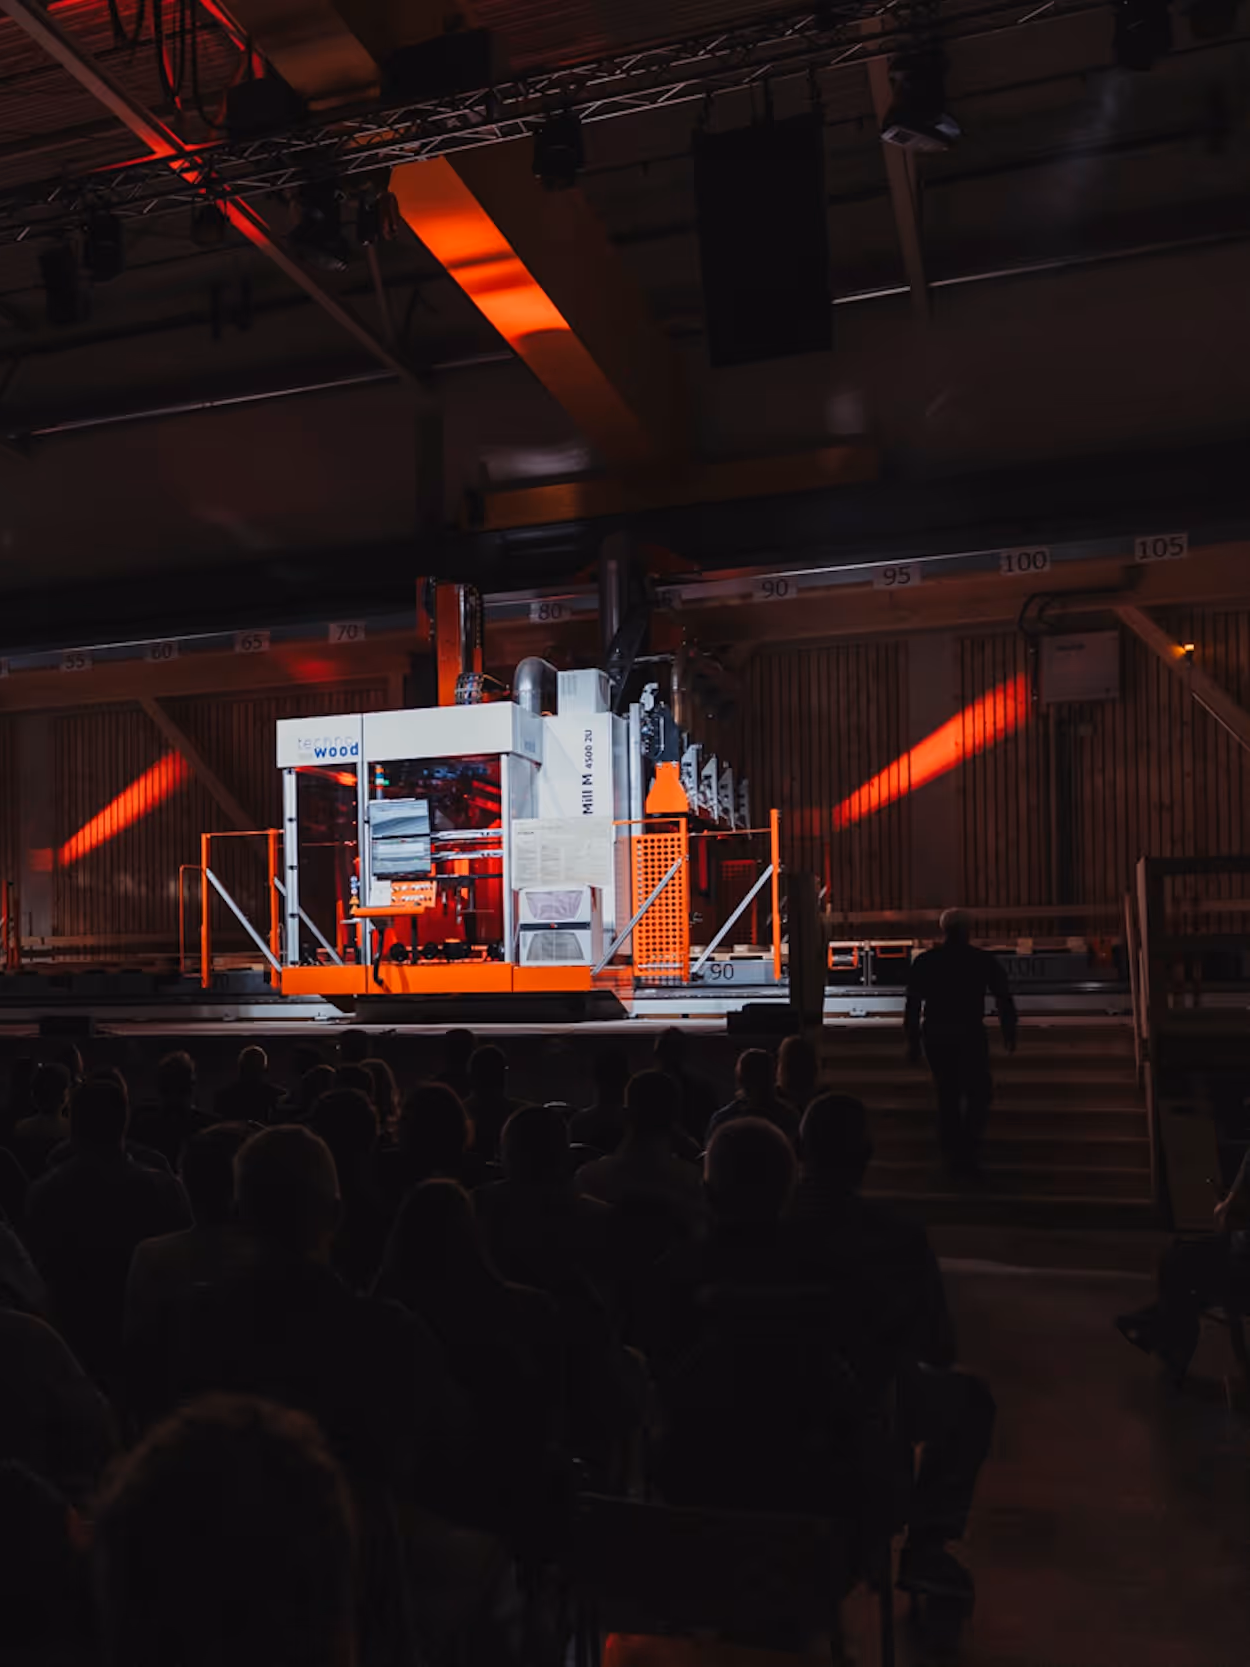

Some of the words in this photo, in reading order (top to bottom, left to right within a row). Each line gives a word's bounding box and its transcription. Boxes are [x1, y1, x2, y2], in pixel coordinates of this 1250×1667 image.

[1140, 537, 1184, 559] 105
[1005, 551, 1047, 573] 100
[883, 566, 910, 586] 95
[761, 580, 789, 598] 90
[538, 603, 562, 620] 80
[337, 624, 357, 640] 70
[151, 643, 172, 659] 60
[241, 635, 263, 651] 65
[65, 655, 85, 669] 55
[585, 729, 593, 742] 2U
[314, 742, 359, 758] wood
[585, 745, 593, 769] 4500
[582, 774, 592, 785] M
[582, 790, 593, 814] Mill
[710, 963, 734, 980] 90
